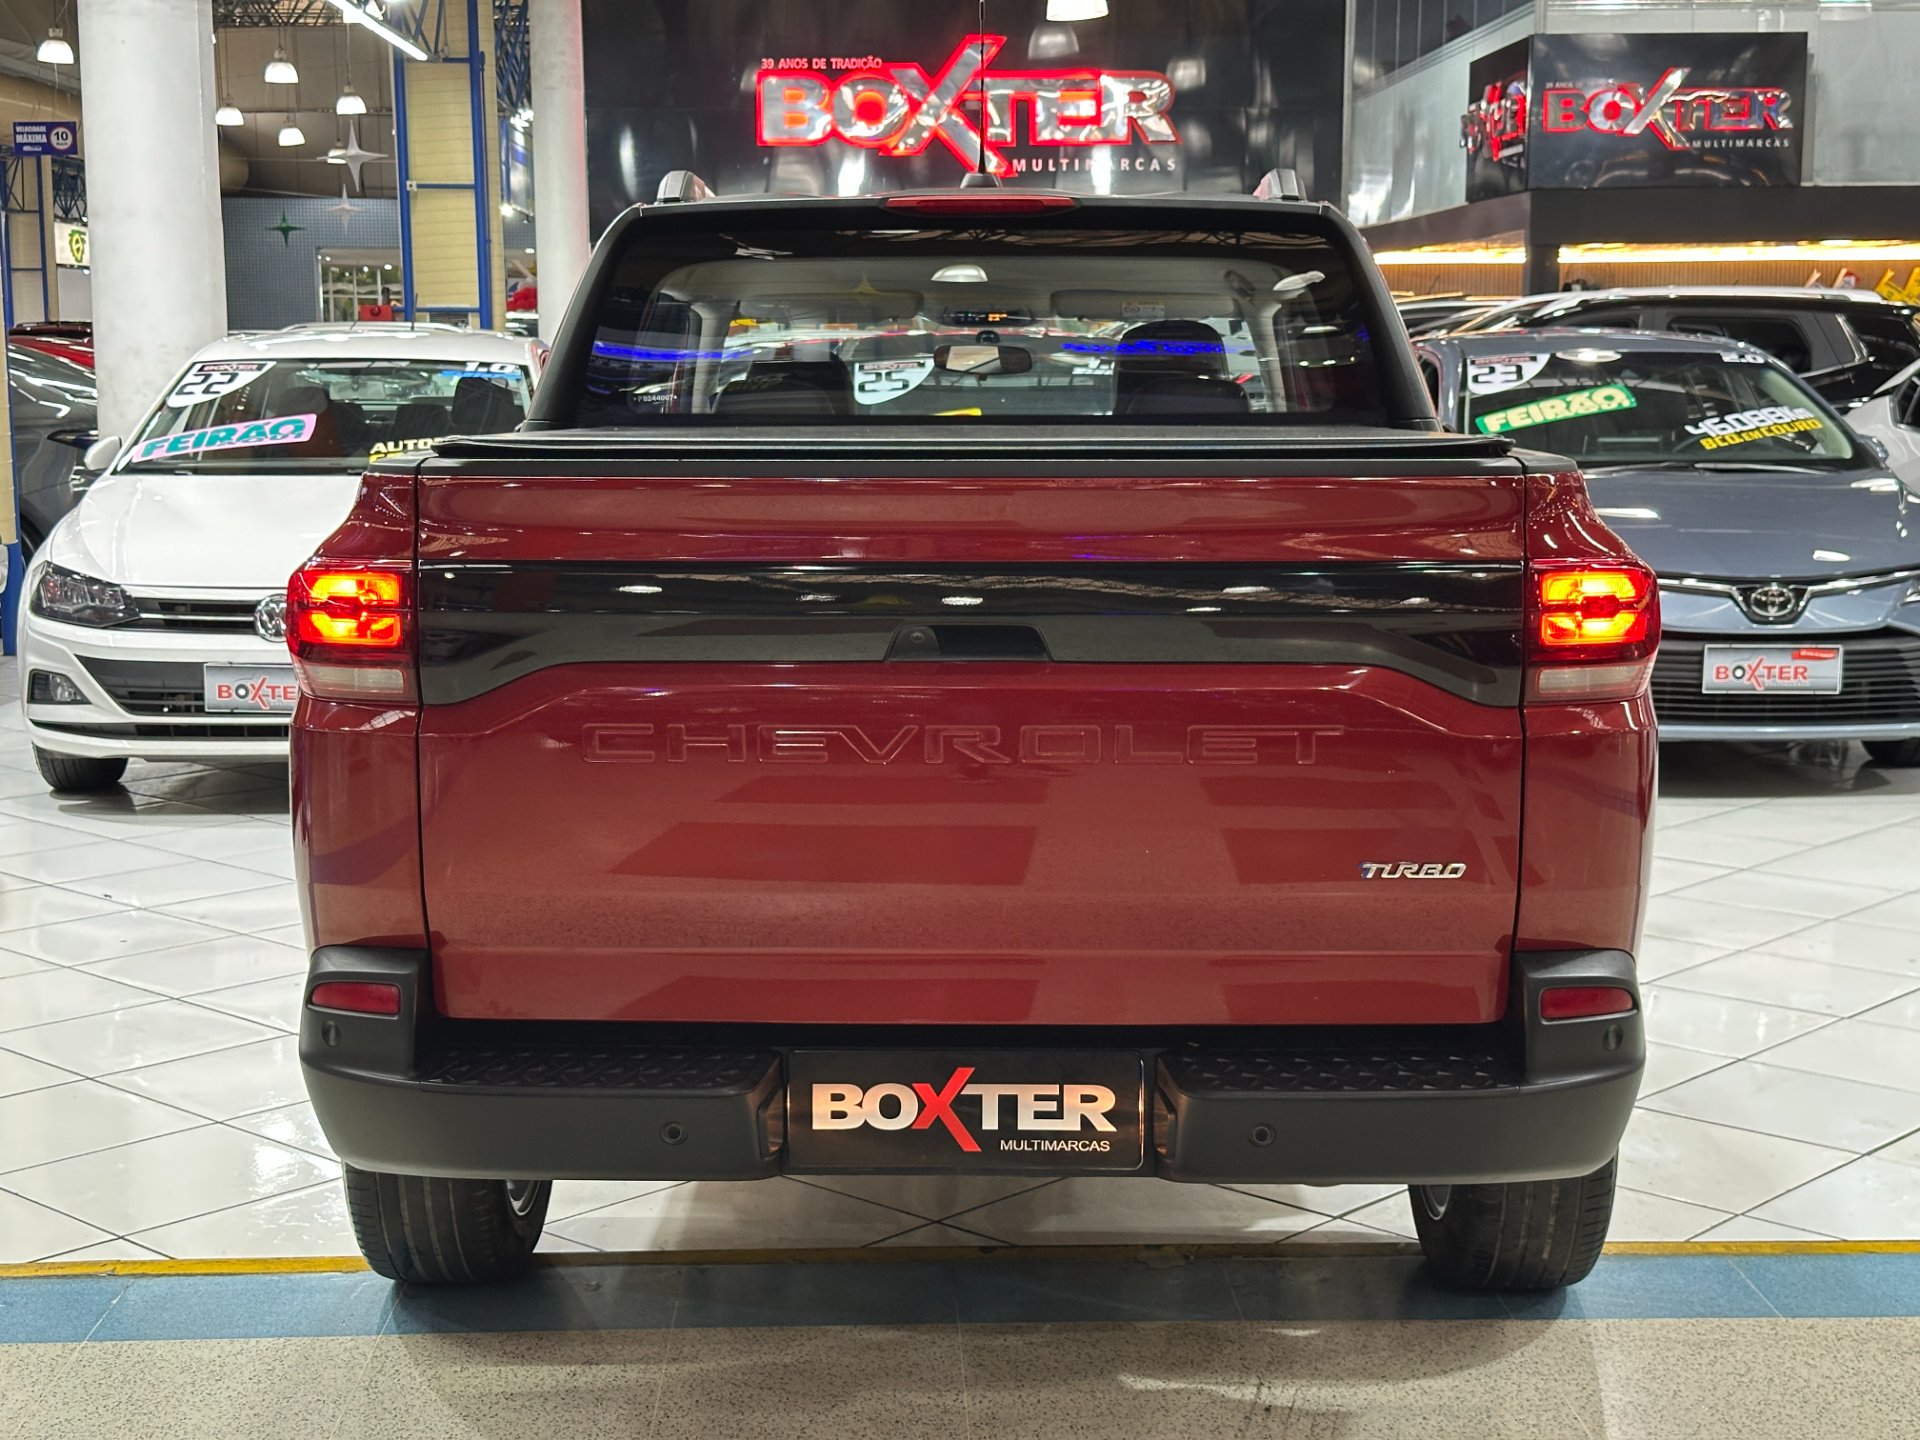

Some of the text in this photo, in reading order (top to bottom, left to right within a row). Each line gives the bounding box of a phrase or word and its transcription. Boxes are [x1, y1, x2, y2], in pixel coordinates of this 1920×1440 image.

[761, 55, 883, 71] 39 ANOS DE TRADIÇÃO
[756, 34, 1182, 178] BOXTER
[1543, 67, 1793, 150] BOXTER
[16, 133, 48, 143] MÁXIMA
[54, 131, 69, 141] 10
[1692, 138, 1790, 149] MULTIMARCAS
[464, 361, 520, 374] 1.0
[1472, 364, 1524, 384] 23
[175, 372, 240, 396] 22
[858, 371, 910, 393] 25
[1483, 387, 1631, 432] FEIRÃO
[140, 418, 306, 458] FEIRÃO
[369, 437, 450, 455] AUTO
[1713, 656, 1809, 690] BOXTER
[216, 676, 298, 710] BOXTE
[582, 723, 1345, 764] CHEVROLET
[1360, 862, 1467, 879] TURBO
[812, 1067, 1117, 1152] BOXTER
[1000, 1139, 1111, 1152] MULTIMARCAS
